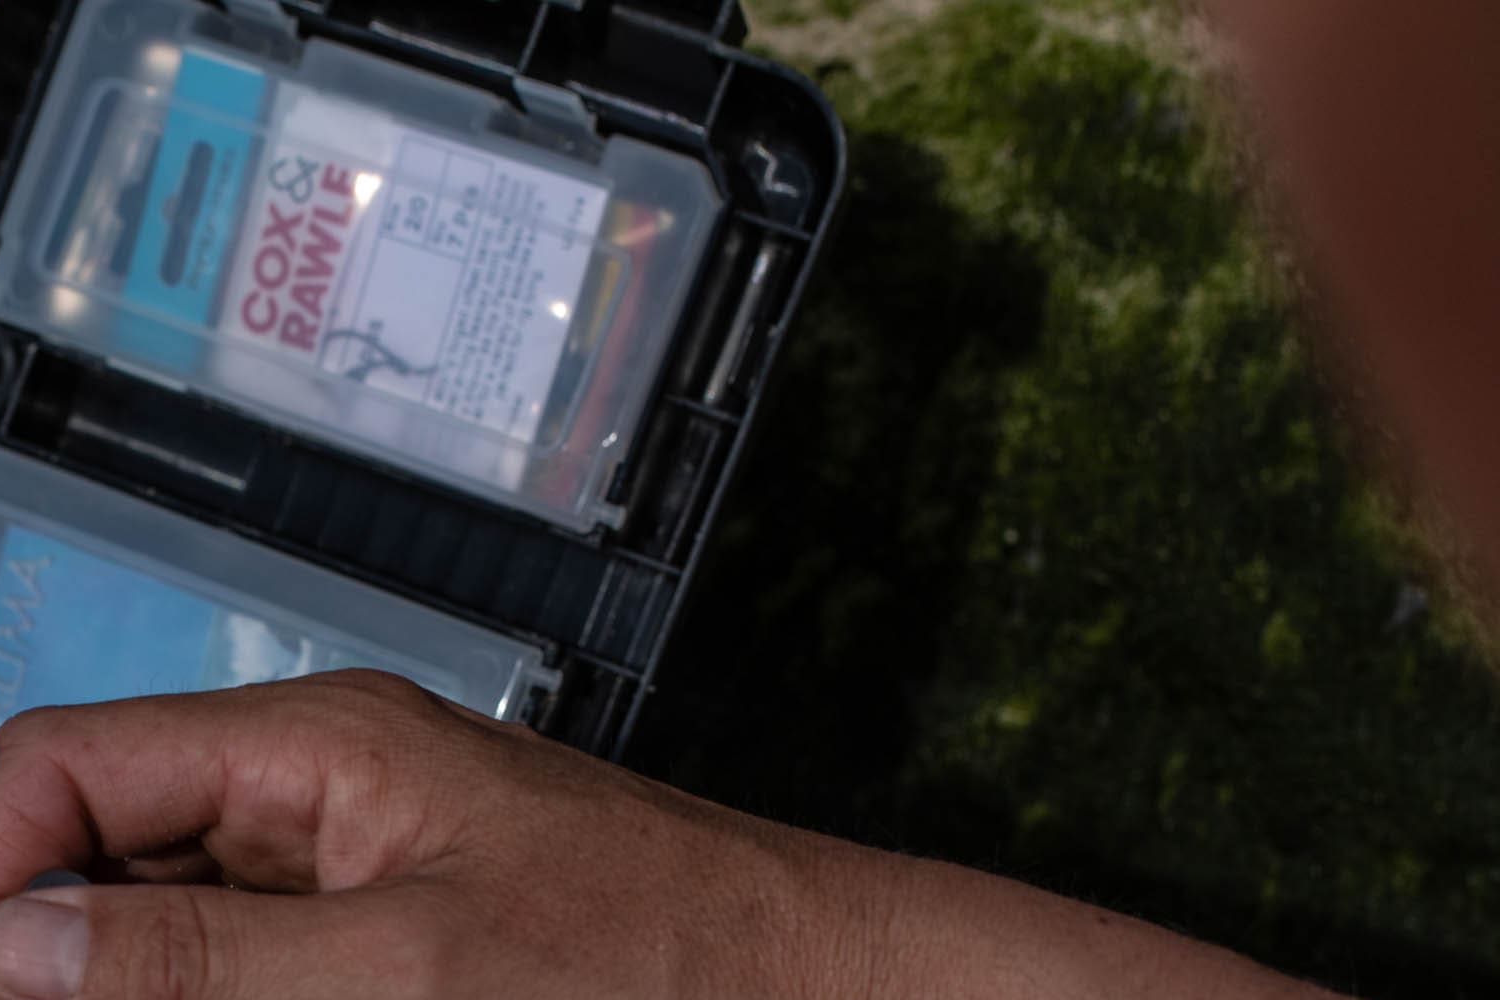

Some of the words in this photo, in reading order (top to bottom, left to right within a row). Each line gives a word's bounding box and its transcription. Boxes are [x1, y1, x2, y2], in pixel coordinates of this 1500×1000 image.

[264, 150, 319, 205] &
[240, 202, 304, 334] COX
[276, 164, 357, 350] RAWLE
